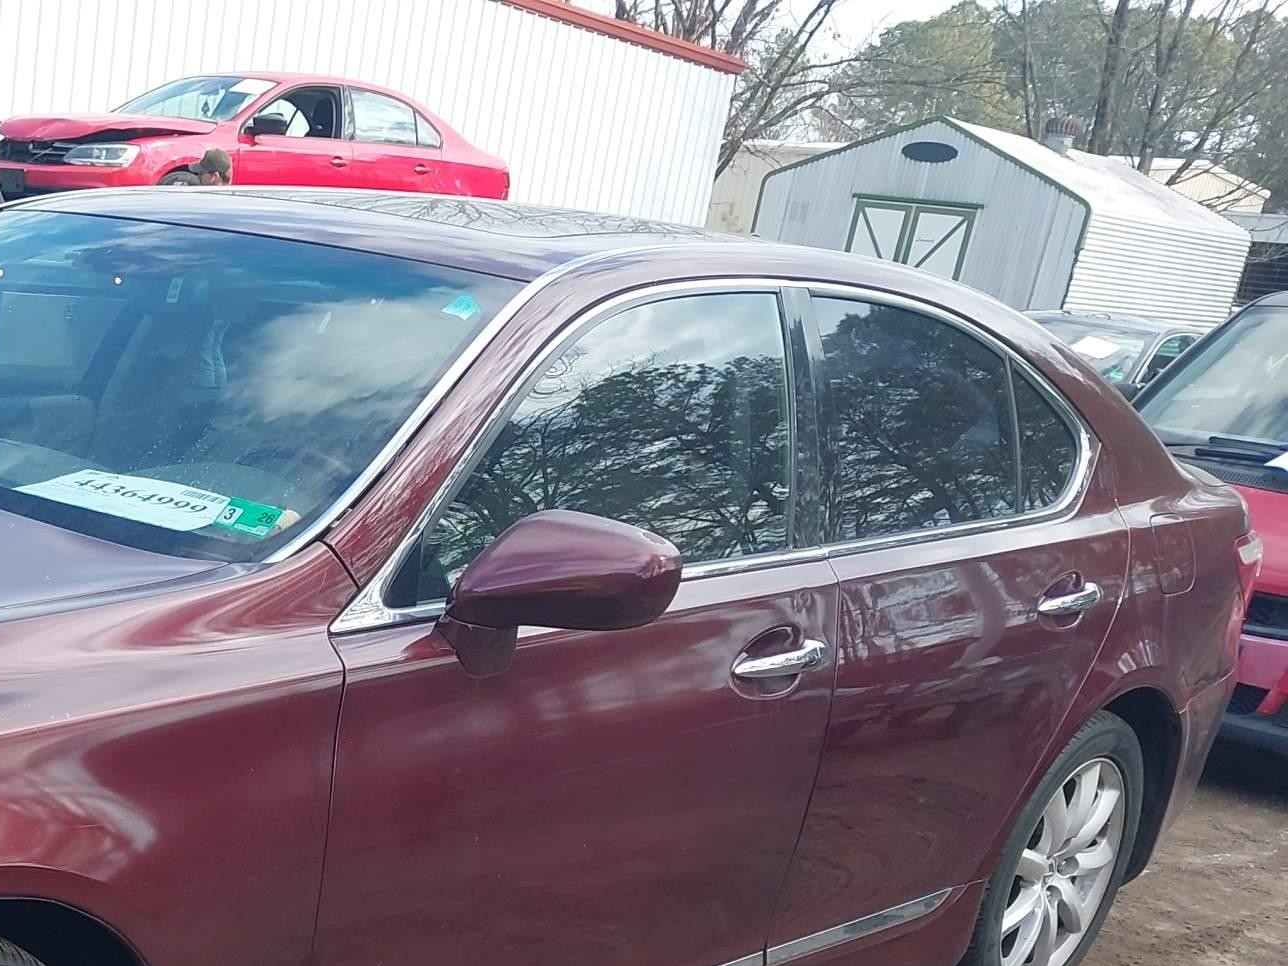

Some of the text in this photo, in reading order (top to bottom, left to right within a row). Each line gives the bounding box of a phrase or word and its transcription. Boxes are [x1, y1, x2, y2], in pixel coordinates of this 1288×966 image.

[74, 479, 208, 514] 44364999
[223, 508, 237, 520] 3
[257, 512, 276, 525] 26
